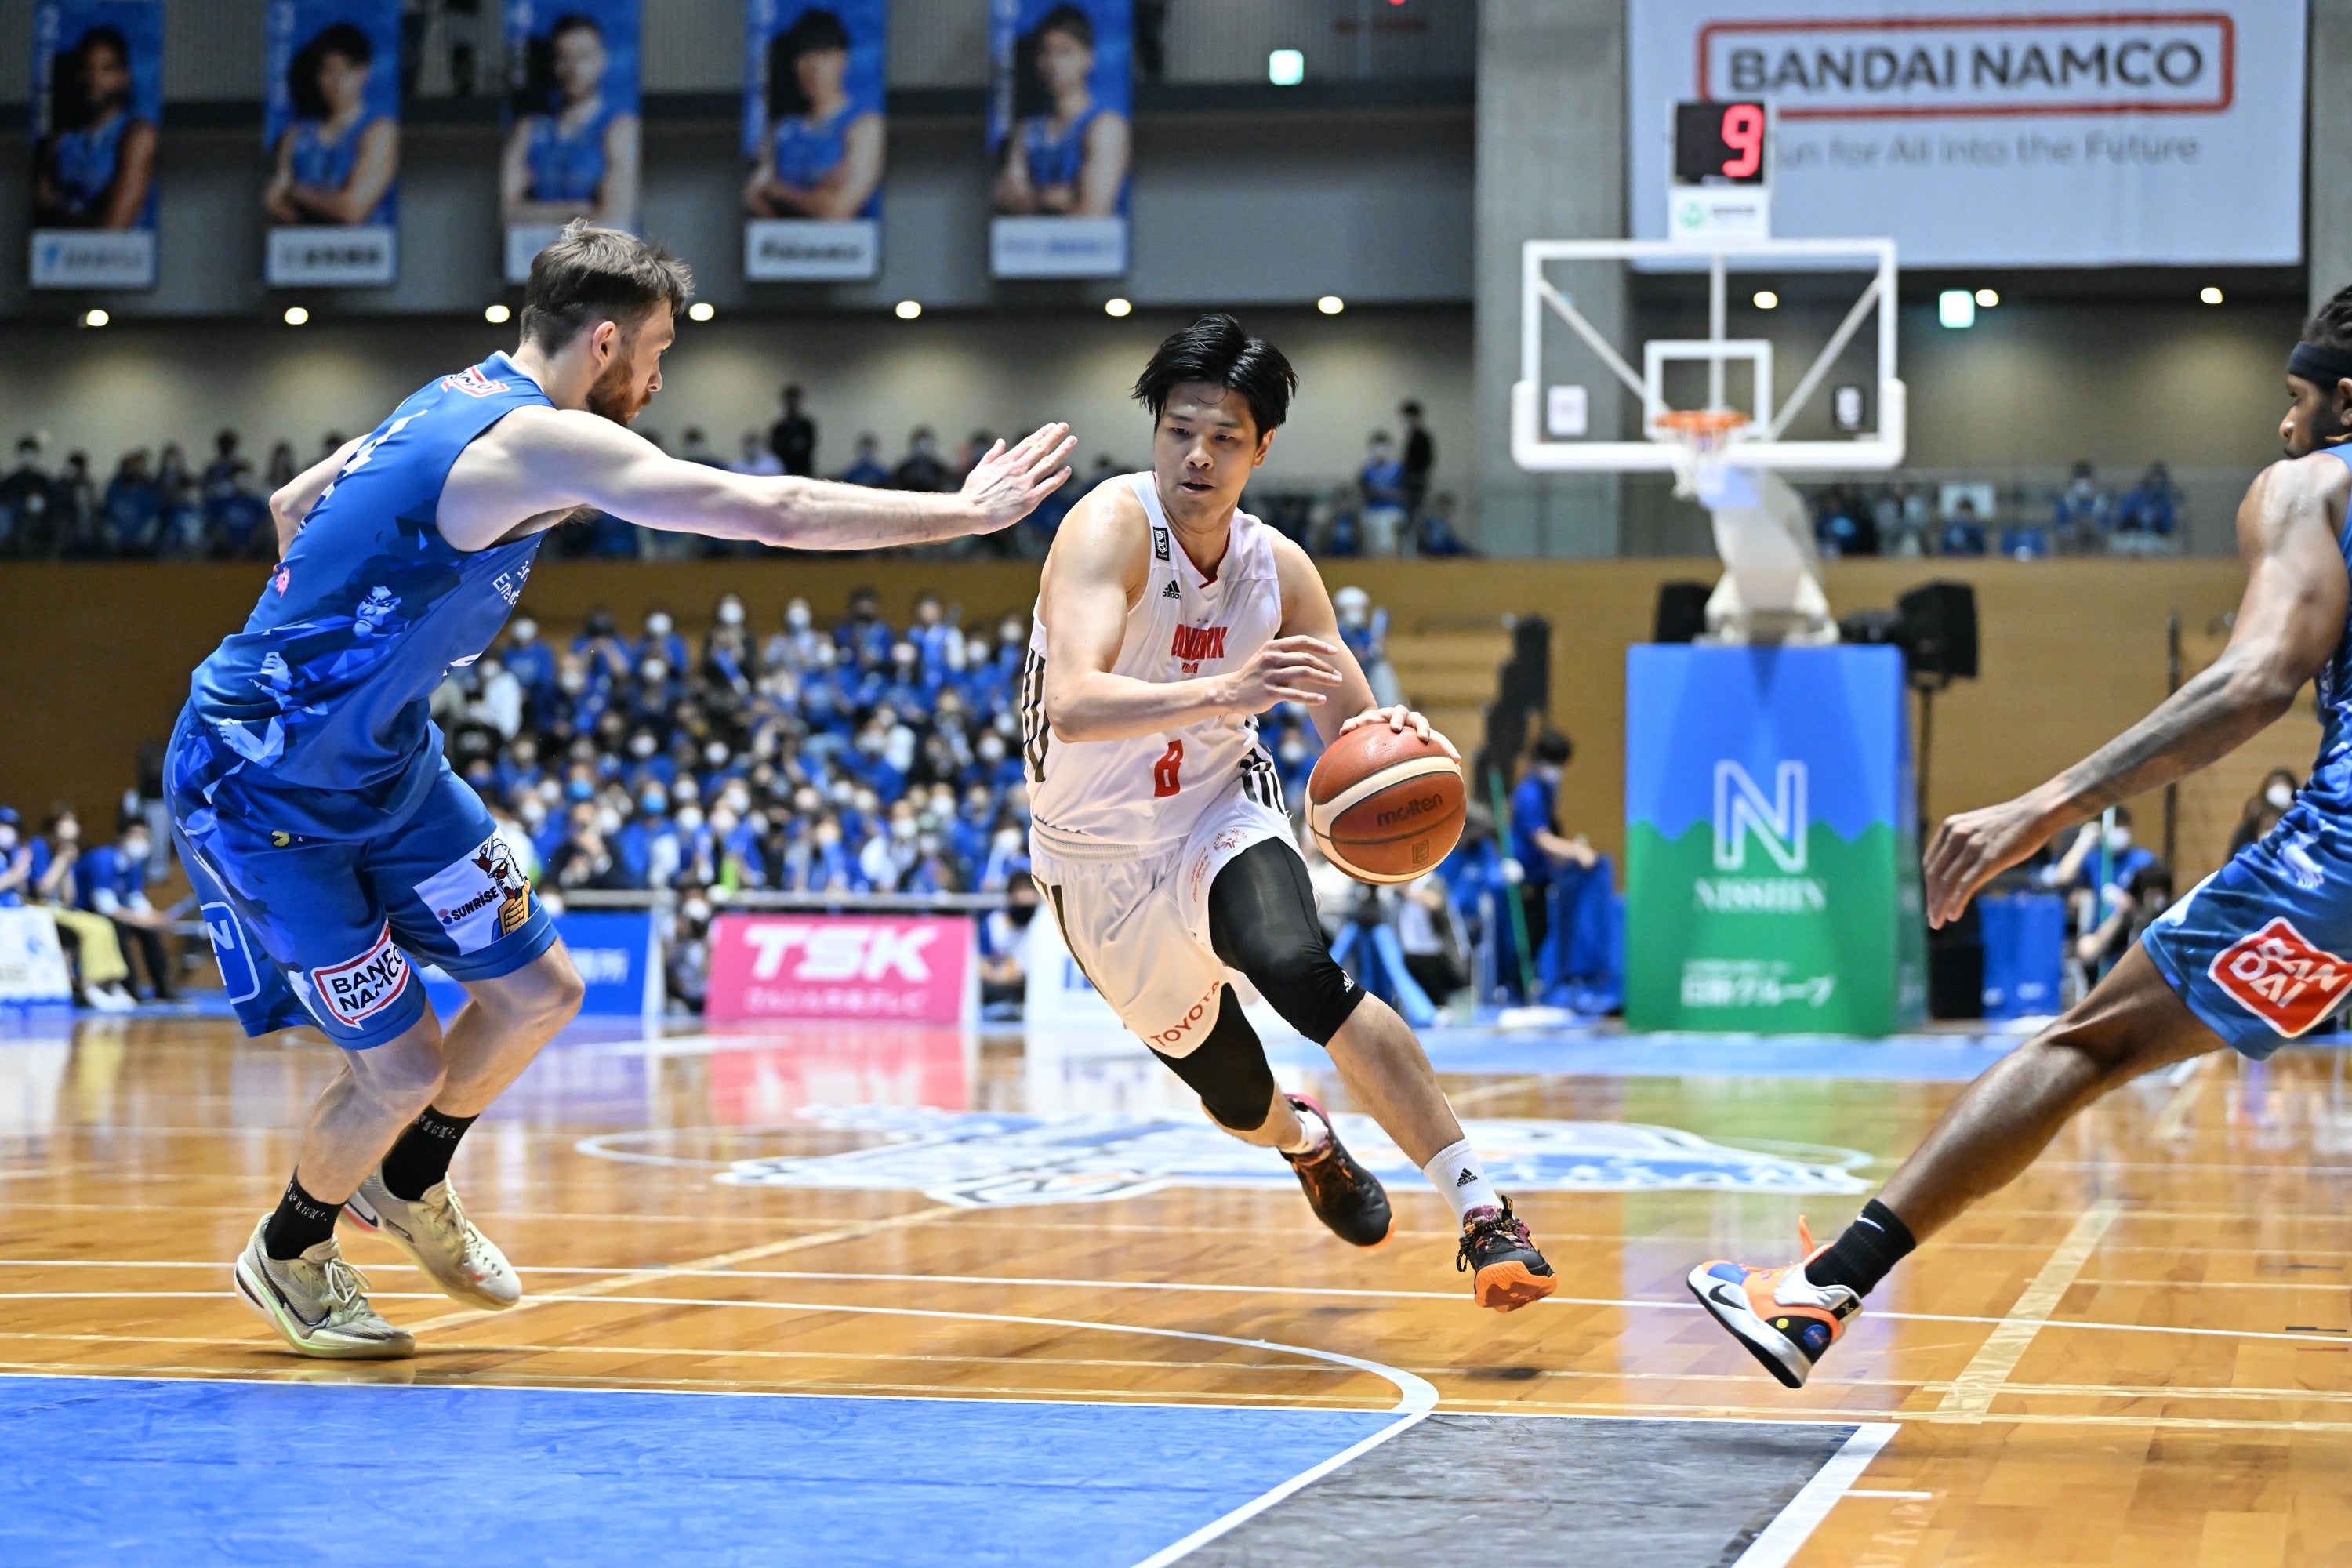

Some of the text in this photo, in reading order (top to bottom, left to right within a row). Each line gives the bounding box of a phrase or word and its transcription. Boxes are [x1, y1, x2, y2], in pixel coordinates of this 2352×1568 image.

[1728, 39, 2203, 93] BANDAI NAMCO
[1721, 103, 1764, 178] 9
[2084, 129, 2201, 165] Future
[1377, 793, 1443, 827] molten
[451, 886, 499, 921] SUNRISE
[339, 945, 403, 1011] NAMCO
[745, 924, 939, 981] TSK
[2228, 950, 2307, 1009] DAI
[2256, 937, 2348, 992] BAN
[1150, 980, 1220, 1047] TOYOTA
[1456, 1174, 1478, 1187] adidas
